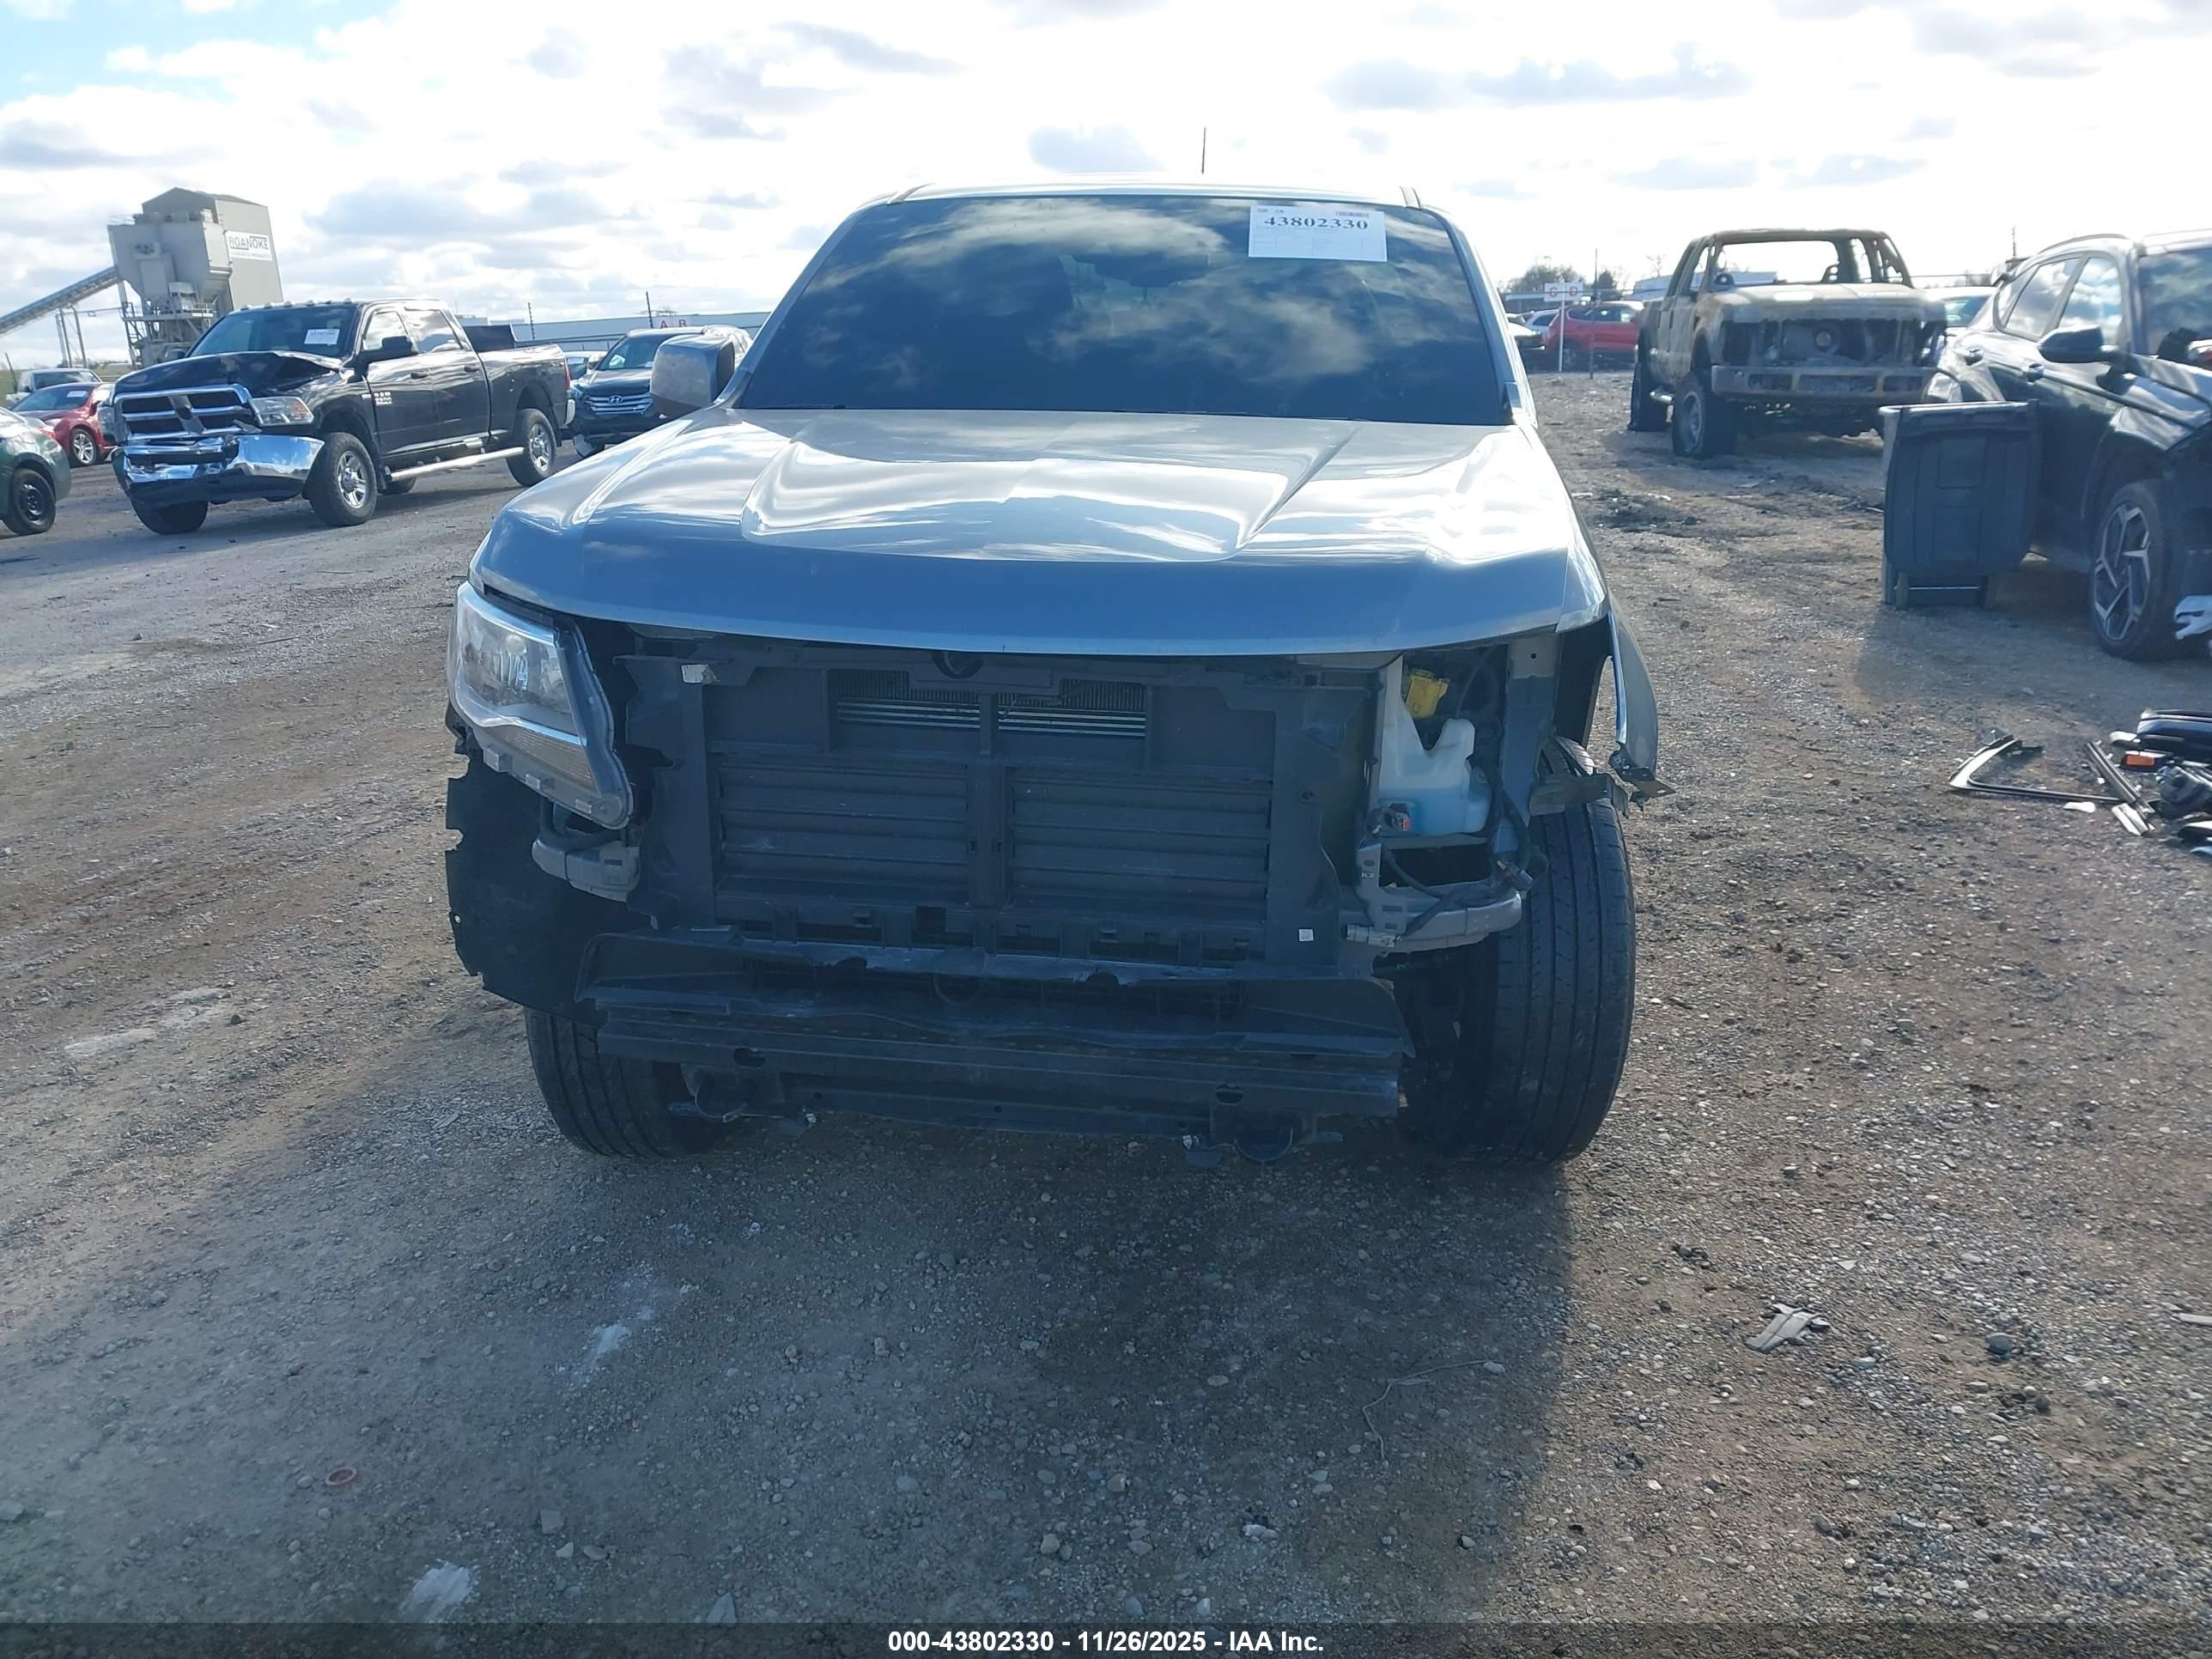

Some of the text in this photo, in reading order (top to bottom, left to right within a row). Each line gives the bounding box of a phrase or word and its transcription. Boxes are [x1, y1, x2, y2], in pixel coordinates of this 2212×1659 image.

[1263, 216, 1368, 230] 43802330
[228, 236, 269, 250] ROANOKE
[659, 319, 668, 329] A
